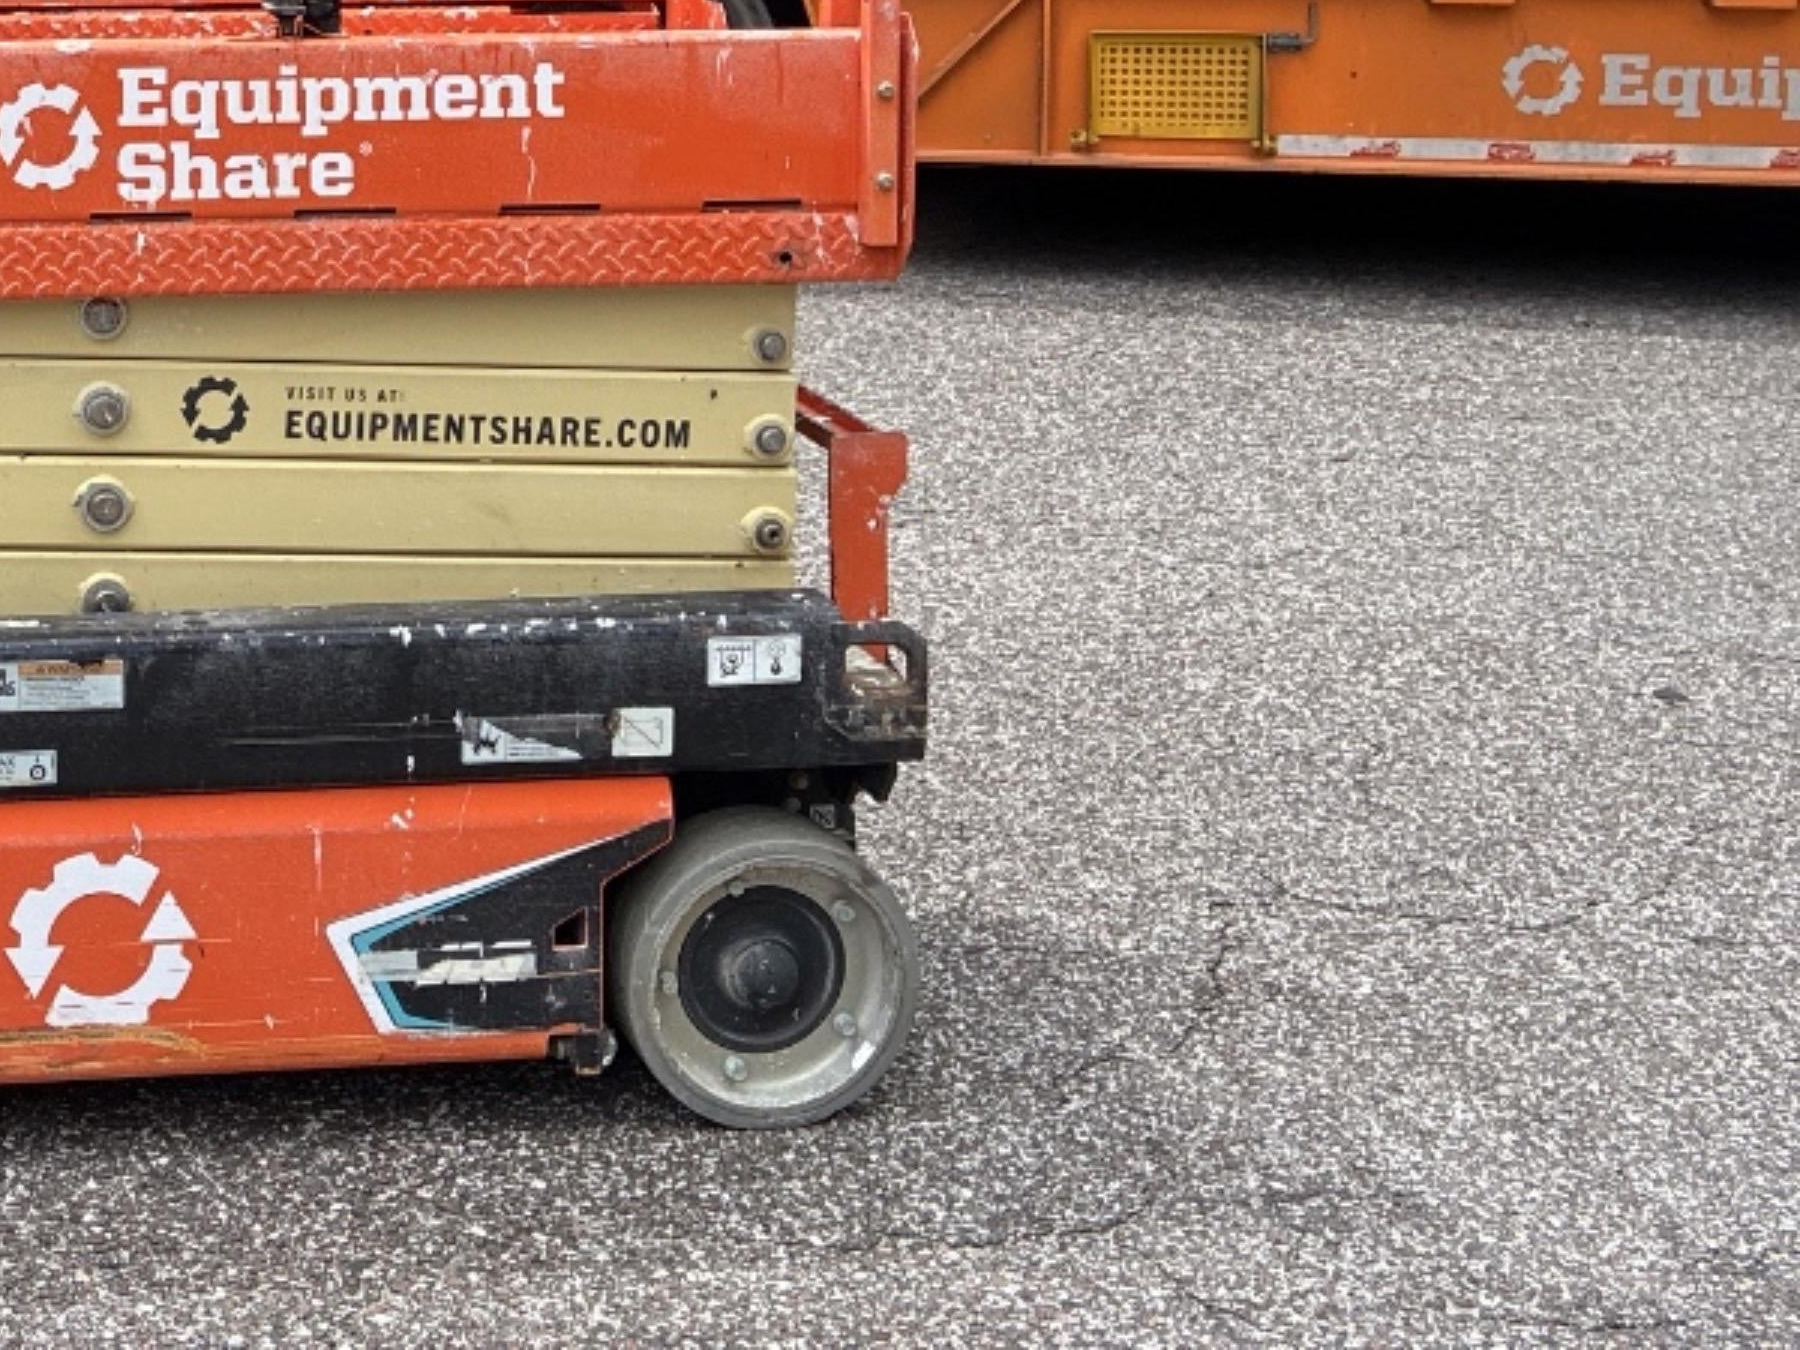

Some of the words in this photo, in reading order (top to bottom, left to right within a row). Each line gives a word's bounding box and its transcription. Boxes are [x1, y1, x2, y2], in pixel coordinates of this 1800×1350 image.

[117, 63, 564, 138] Equipment
[117, 142, 354, 202] Share
[284, 386, 336, 400] VISIT
[344, 387, 367, 402] US
[284, 410, 691, 449] EQUIPMENTSHARE.COM
